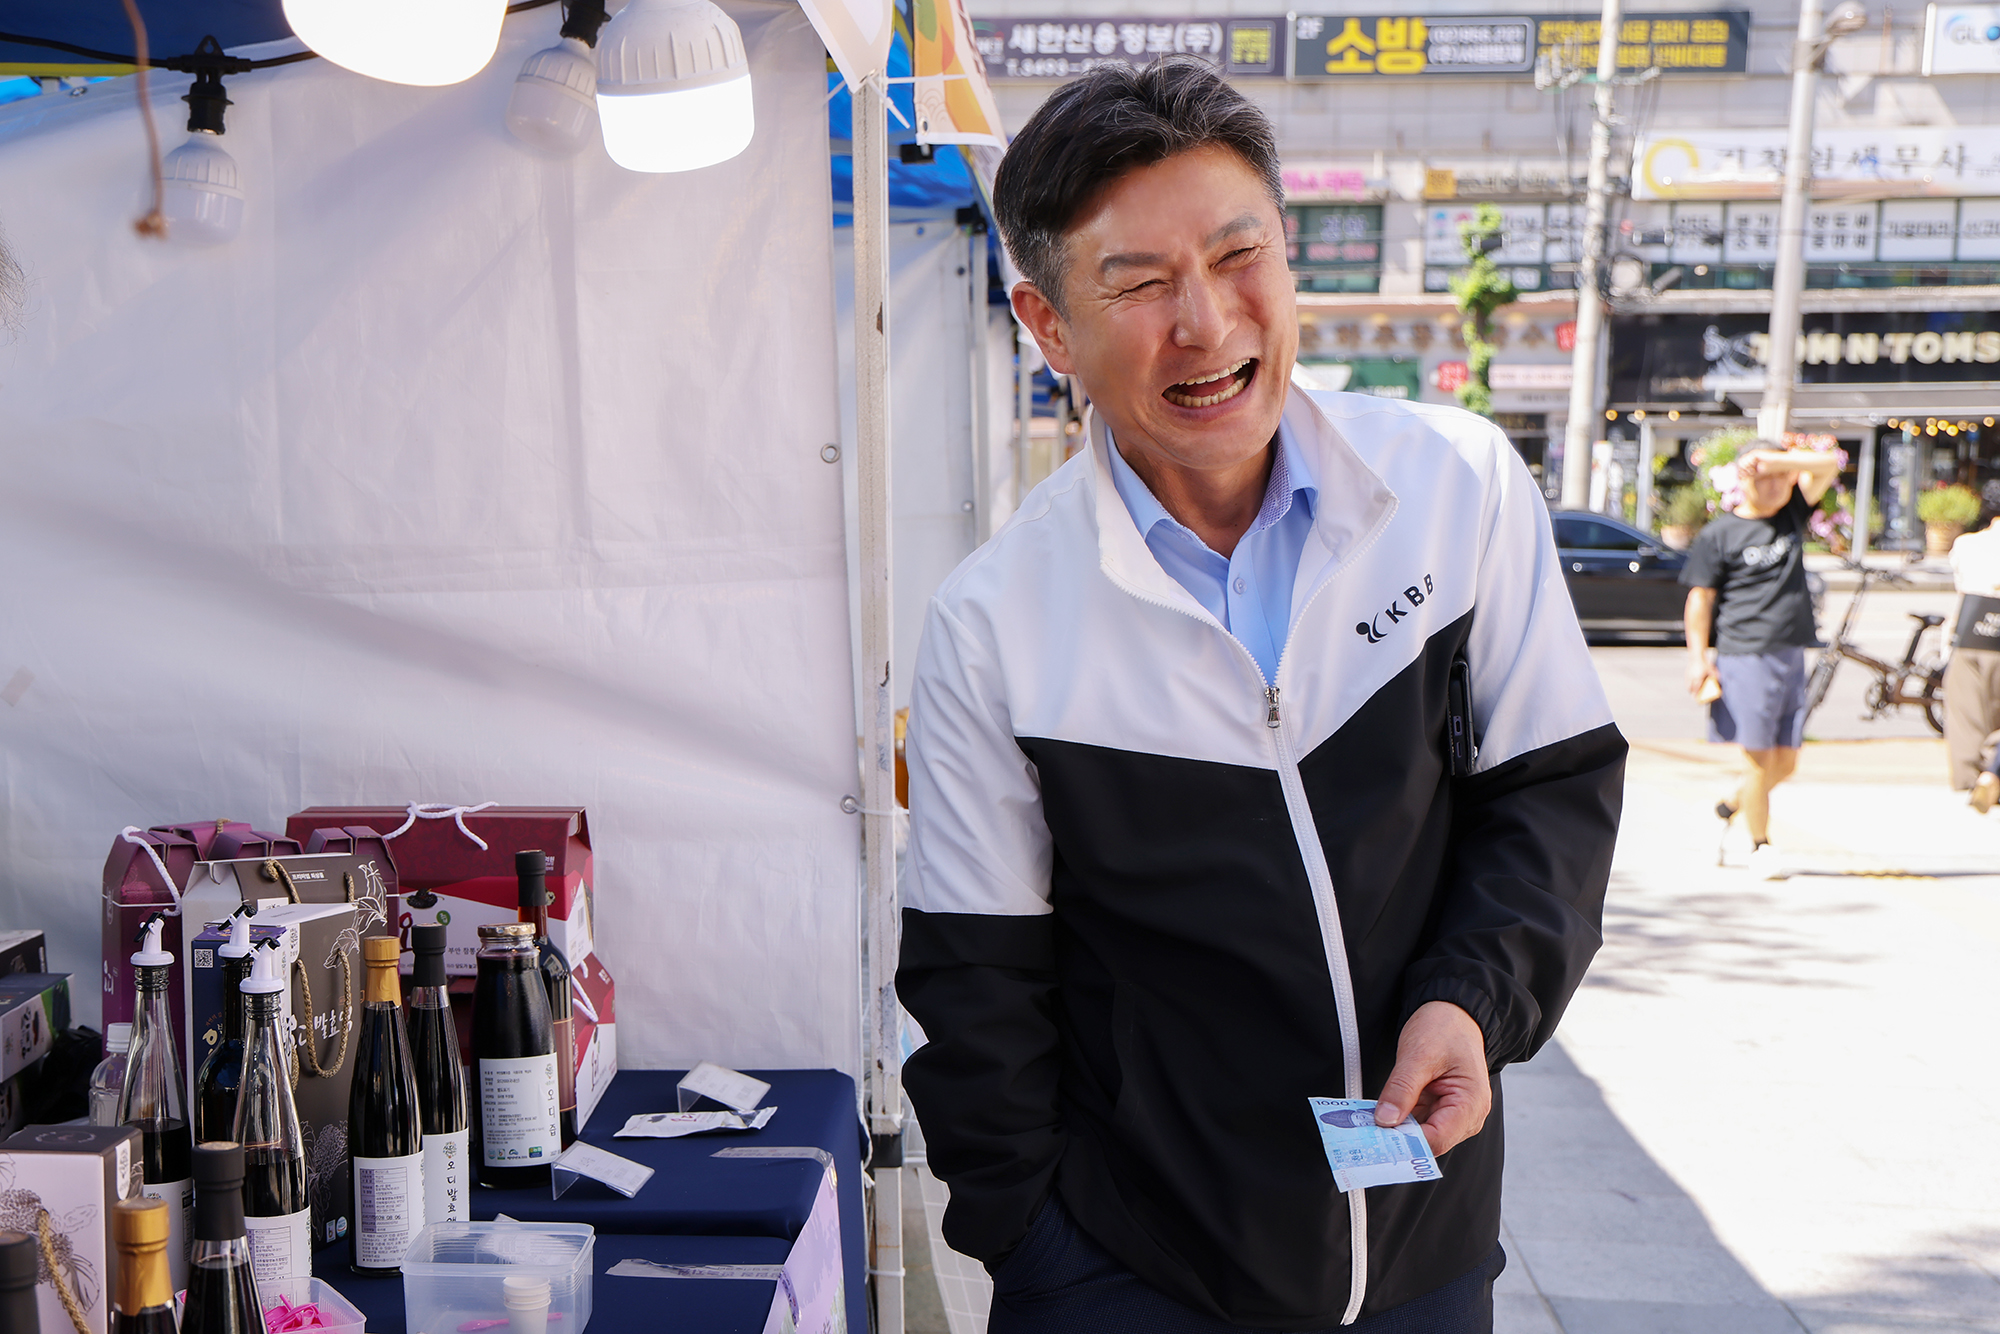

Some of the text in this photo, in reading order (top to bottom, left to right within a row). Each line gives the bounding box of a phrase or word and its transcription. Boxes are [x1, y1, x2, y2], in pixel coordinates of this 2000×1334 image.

[1325, 17, 1428, 75] 소방
[1749, 331, 2000, 365] TM N TOMS
